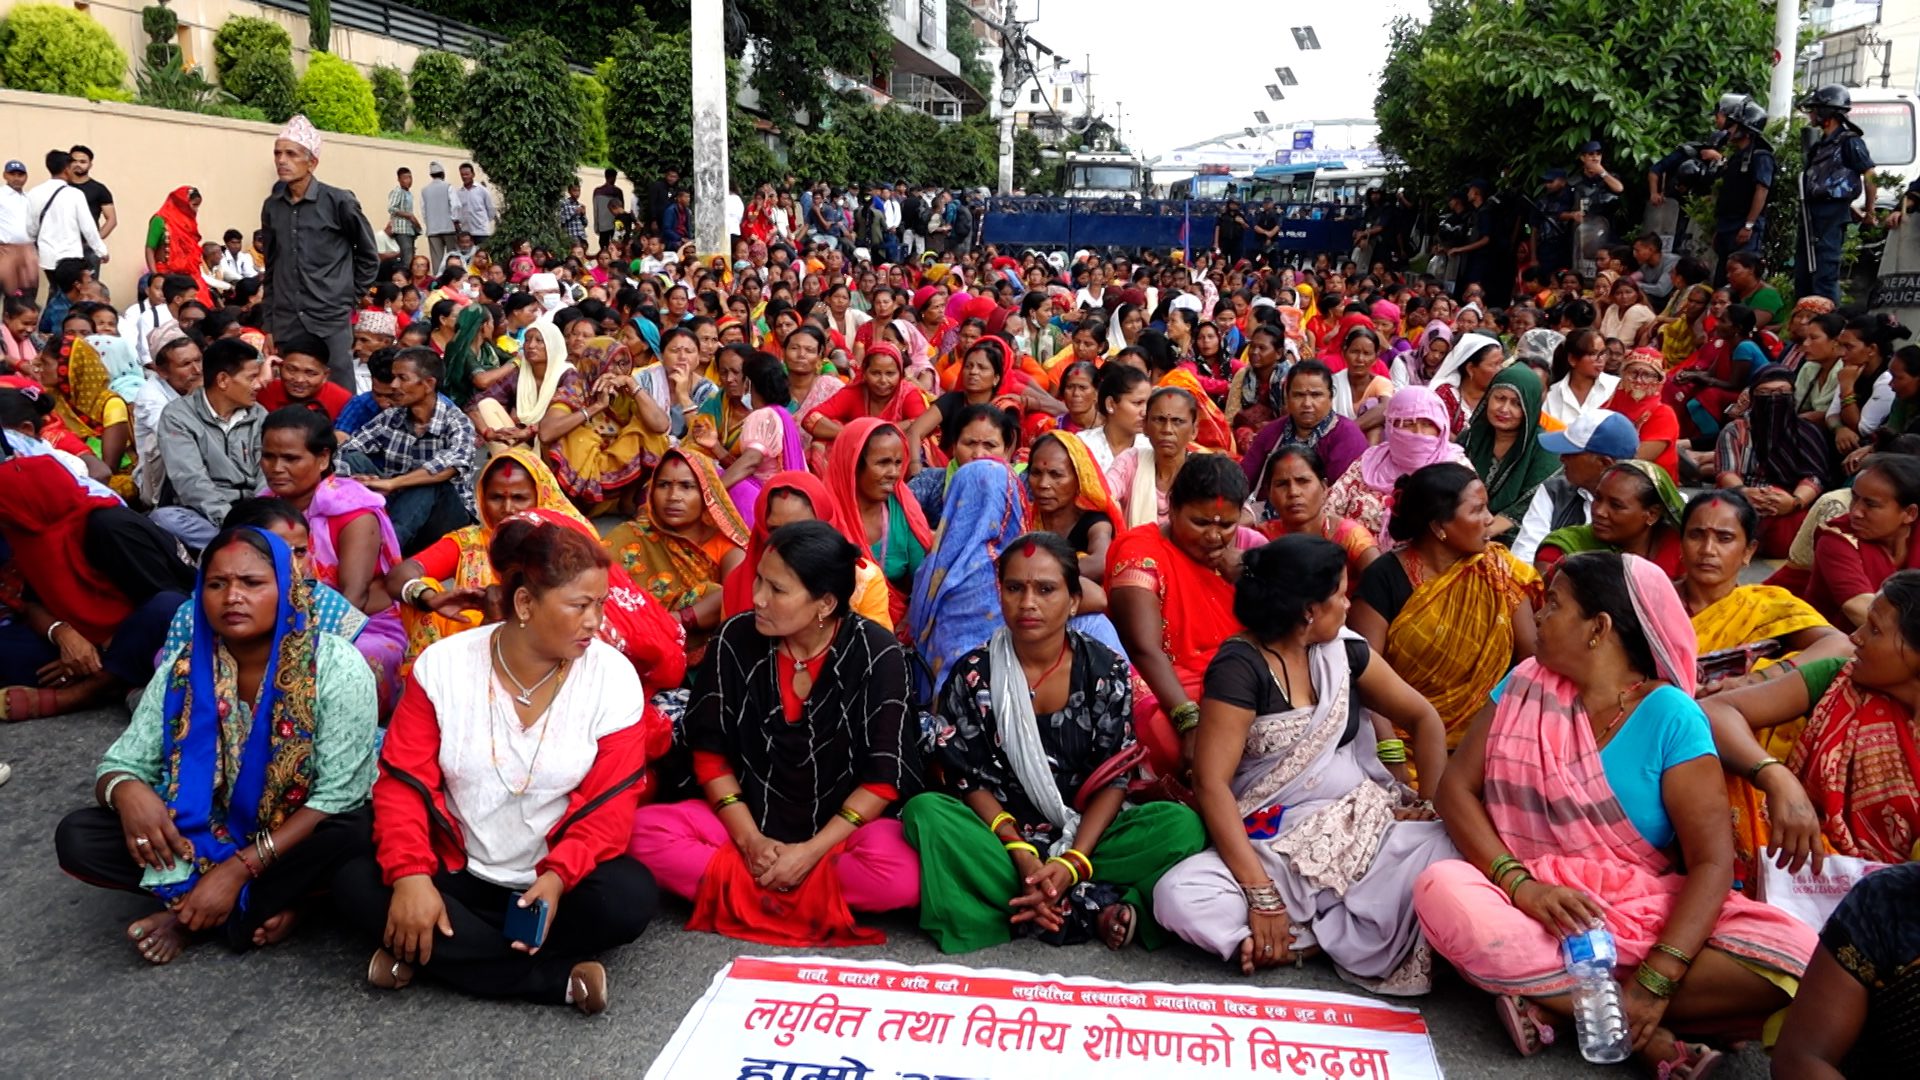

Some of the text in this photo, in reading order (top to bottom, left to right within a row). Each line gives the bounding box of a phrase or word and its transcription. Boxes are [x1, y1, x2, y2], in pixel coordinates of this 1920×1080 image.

[1878, 290, 1920, 304] POLICE
[744, 992, 871, 1046] लघुवित्त
[878, 1009, 955, 1045] तथा
[962, 1004, 1072, 1054] वित्तीय
[1083, 1013, 1235, 1068] शोषणको
